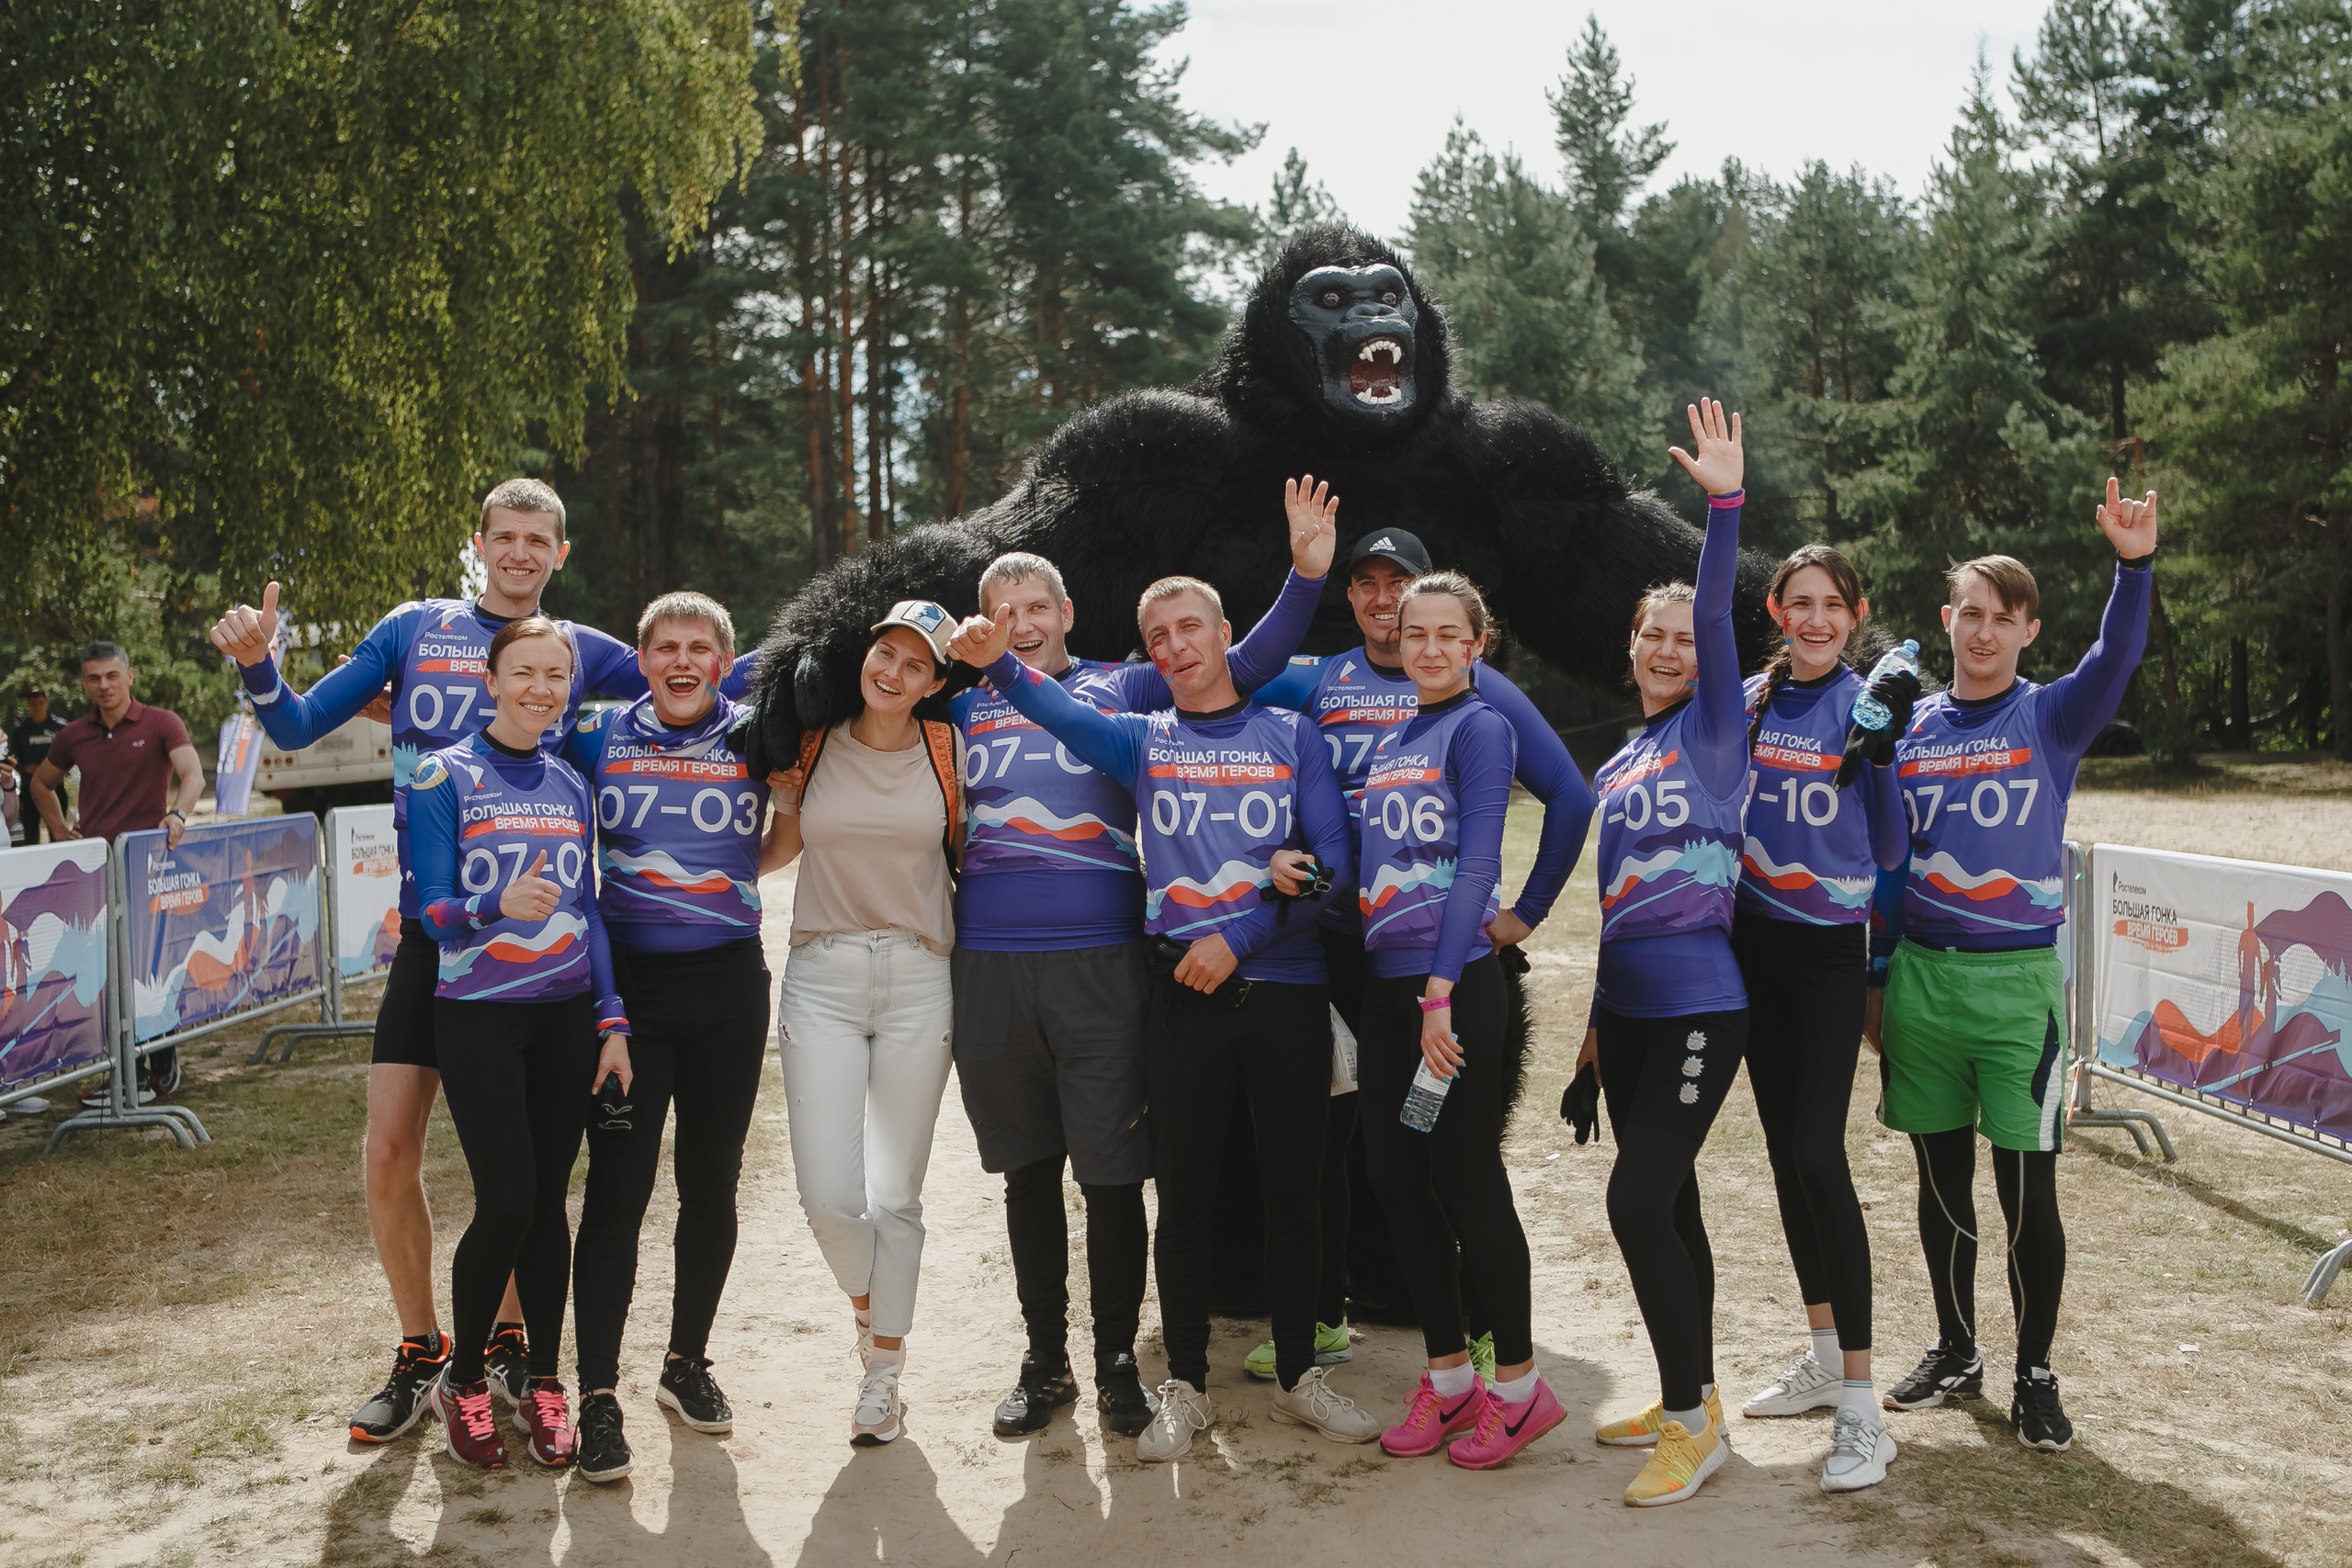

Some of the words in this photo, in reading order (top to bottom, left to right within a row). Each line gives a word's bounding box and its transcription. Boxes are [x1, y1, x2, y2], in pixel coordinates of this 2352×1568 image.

[424, 631, 469, 641] Ростелеком
[418, 643, 491, 659] БОЛЬША
[1319, 695, 1395, 709] БОЛЬШАЯ
[1348, 709, 1396, 721] ВРЕМЯ
[1781, 733, 1822, 753] ГОНКА
[1897, 742, 1964, 763] БОЛЬШАЯ
[1964, 737, 2009, 752] ГОНКА
[1148, 747, 1216, 763] БОЛЬШАЯ
[1220, 750, 1273, 764] ГОНКА
[1394, 753, 1429, 769] ГОНКА
[1775, 748, 1822, 767] ГЕРОЕВ
[1917, 756, 1962, 773] ВРЕМЯ
[1964, 752, 2011, 769] ГЕРОЕВ
[631, 760, 680, 773] ВРЕМЯ
[683, 761, 738, 777] ГЕРОЕВ
[1177, 765, 1218, 779] ВРЕМЯ
[1221, 765, 1275, 778] ГЕРОЕВ
[1387, 768, 1426, 782] ГЕРОЕВ
[462, 801, 533, 824] БОЛЬШАЯ
[536, 803, 575, 817] ГОНКА
[598, 785, 759, 836] 07-03
[1151, 789, 1294, 839] 07-01
[494, 818, 538, 830] ВРЕМЯ
[540, 817, 581, 833] ГЕРОЕВ
[461, 841, 588, 895] 07-0
[148, 874, 180, 896] БОЛЬШАЯ
[180, 870, 201, 889] ГОНКА
[2119, 881, 2147, 895] Ростелеком
[160, 893, 181, 910] ВРЕМЯ
[182, 887, 204, 907] ГЕРОЕВ
[2113, 899, 2150, 921] БОЛЬШАЯ
[2151, 905, 2177, 926] ГОНКА
[2127, 921, 2150, 941] ВРЕМЯ
[2151, 924, 2179, 945] ГЕРОЕВ
